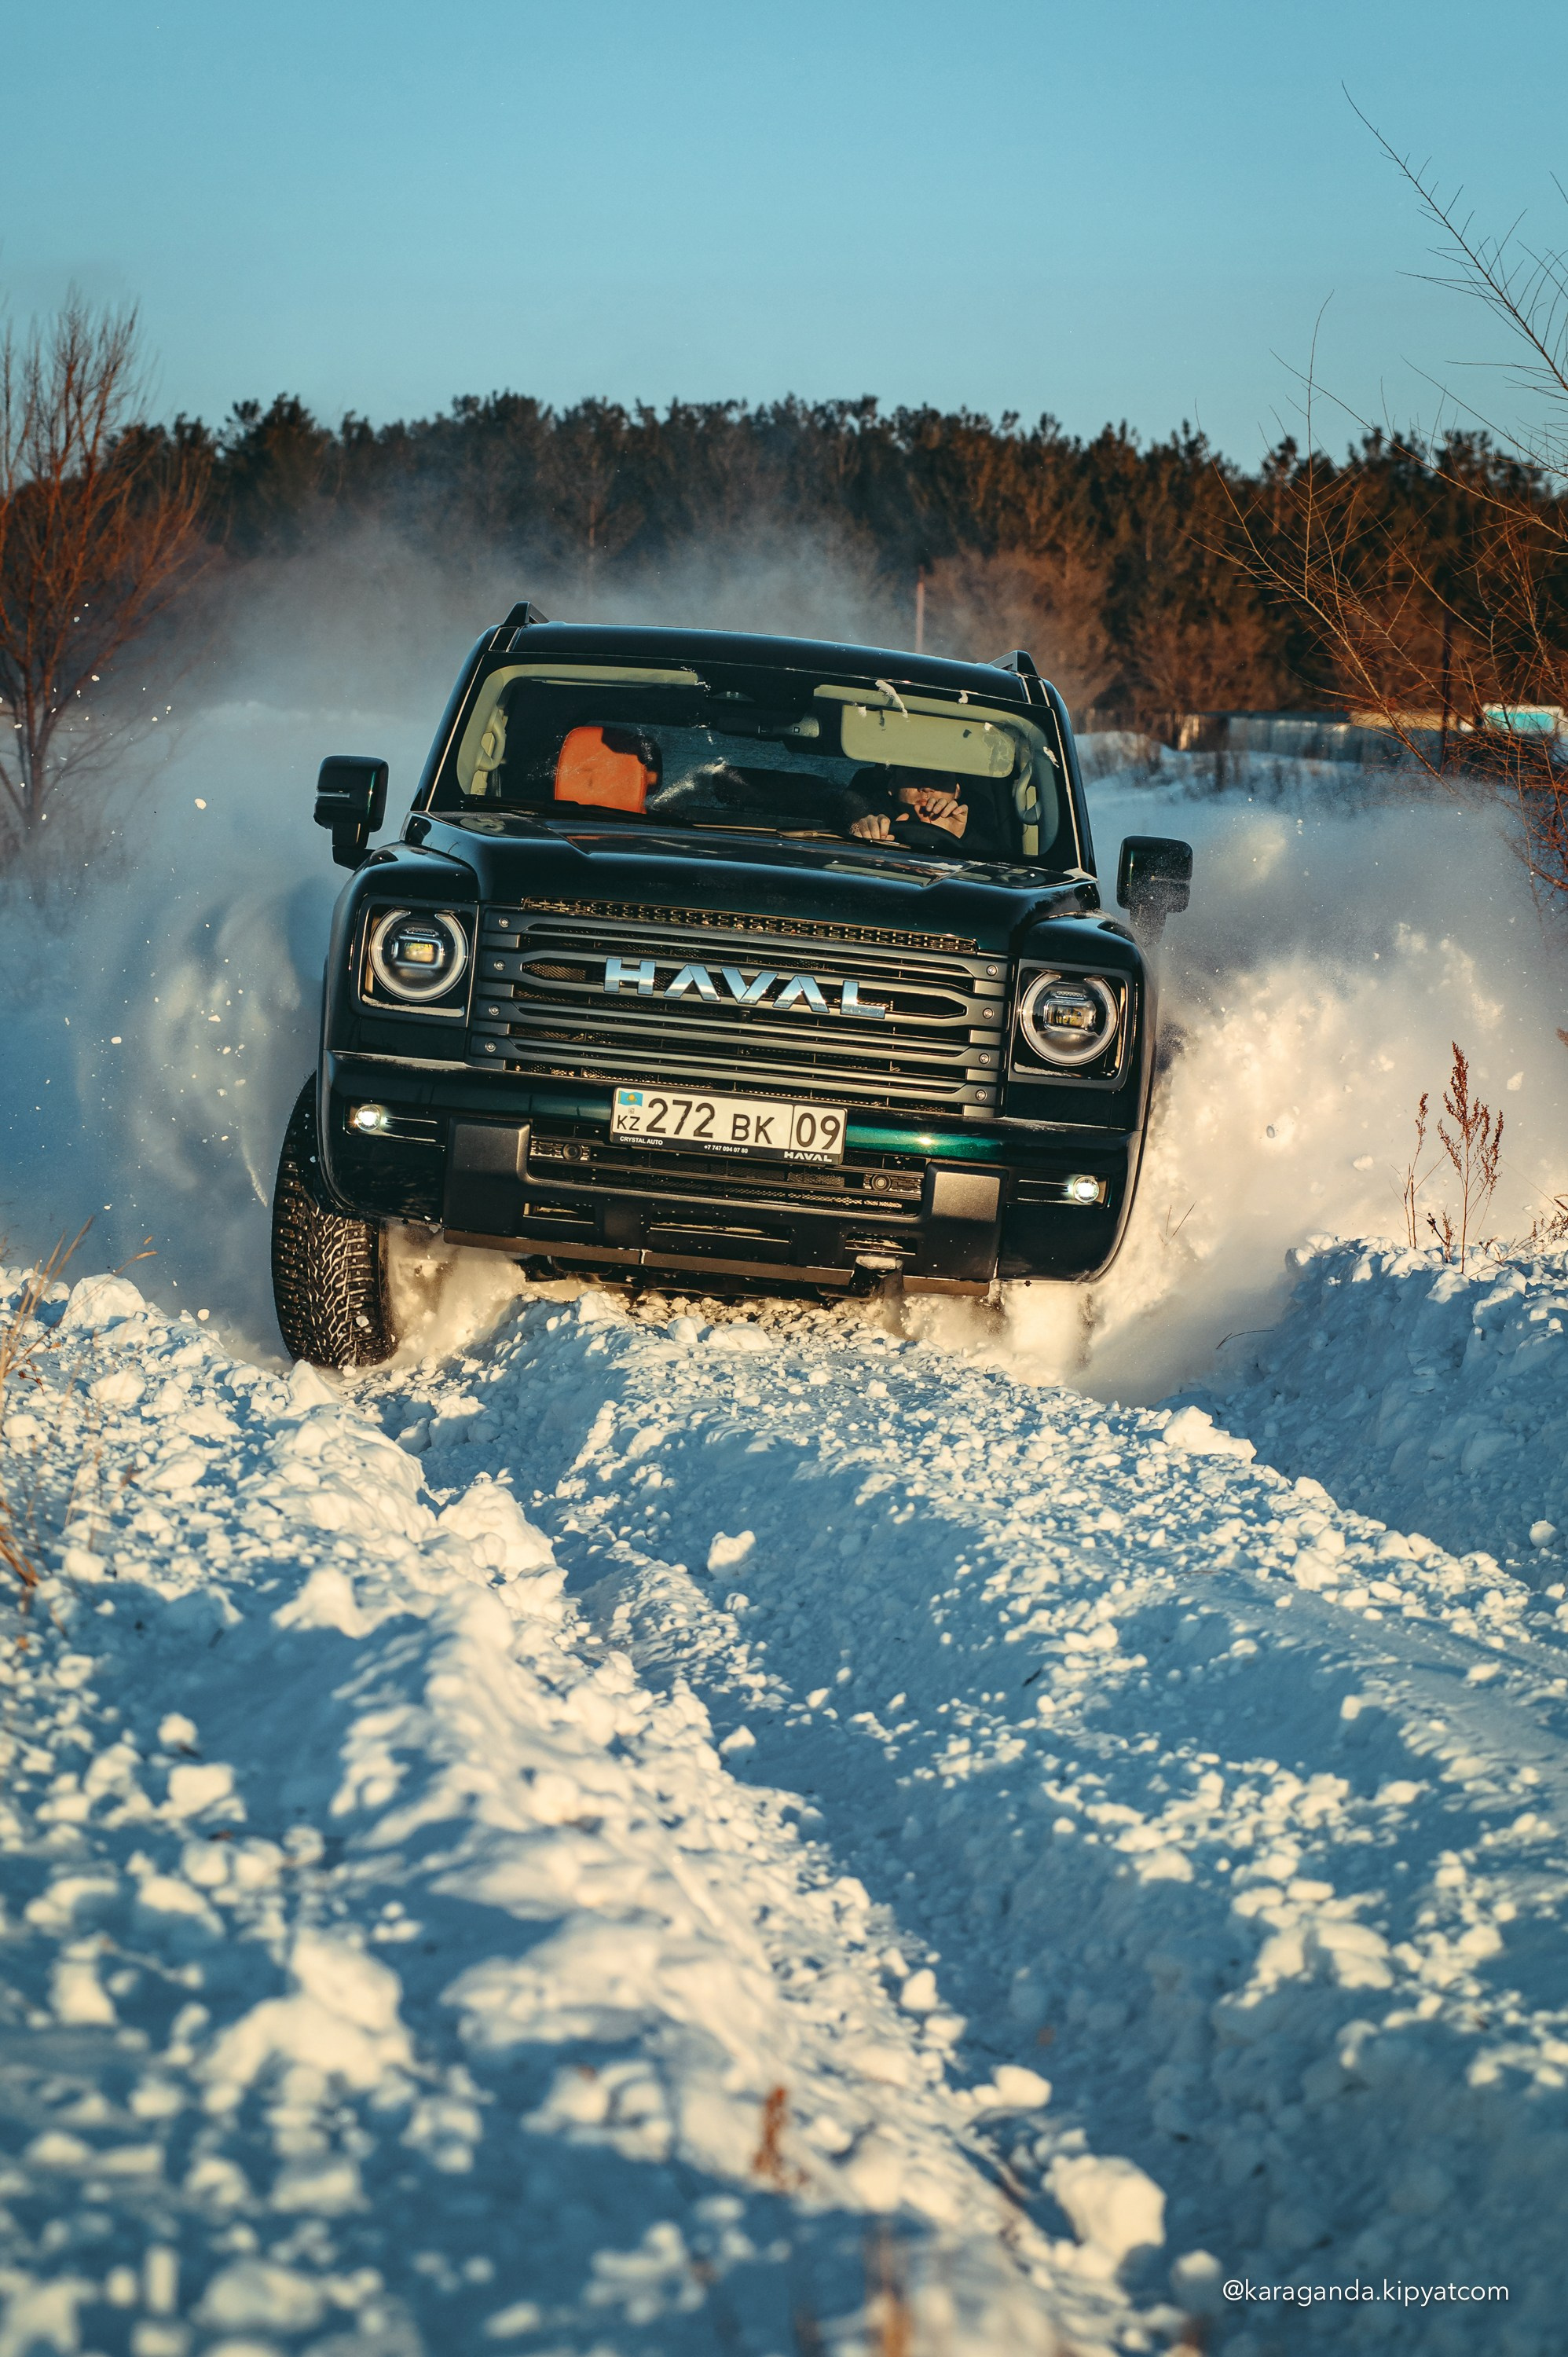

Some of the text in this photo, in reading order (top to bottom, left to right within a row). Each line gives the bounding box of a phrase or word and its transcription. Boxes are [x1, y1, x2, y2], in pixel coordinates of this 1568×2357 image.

[603, 957, 886, 1020] HAVAL
[616, 1115, 641, 1131] KZ
[646, 1098, 841, 1149] 272 BK 09
[784, 1151, 833, 1162] HAVAL
